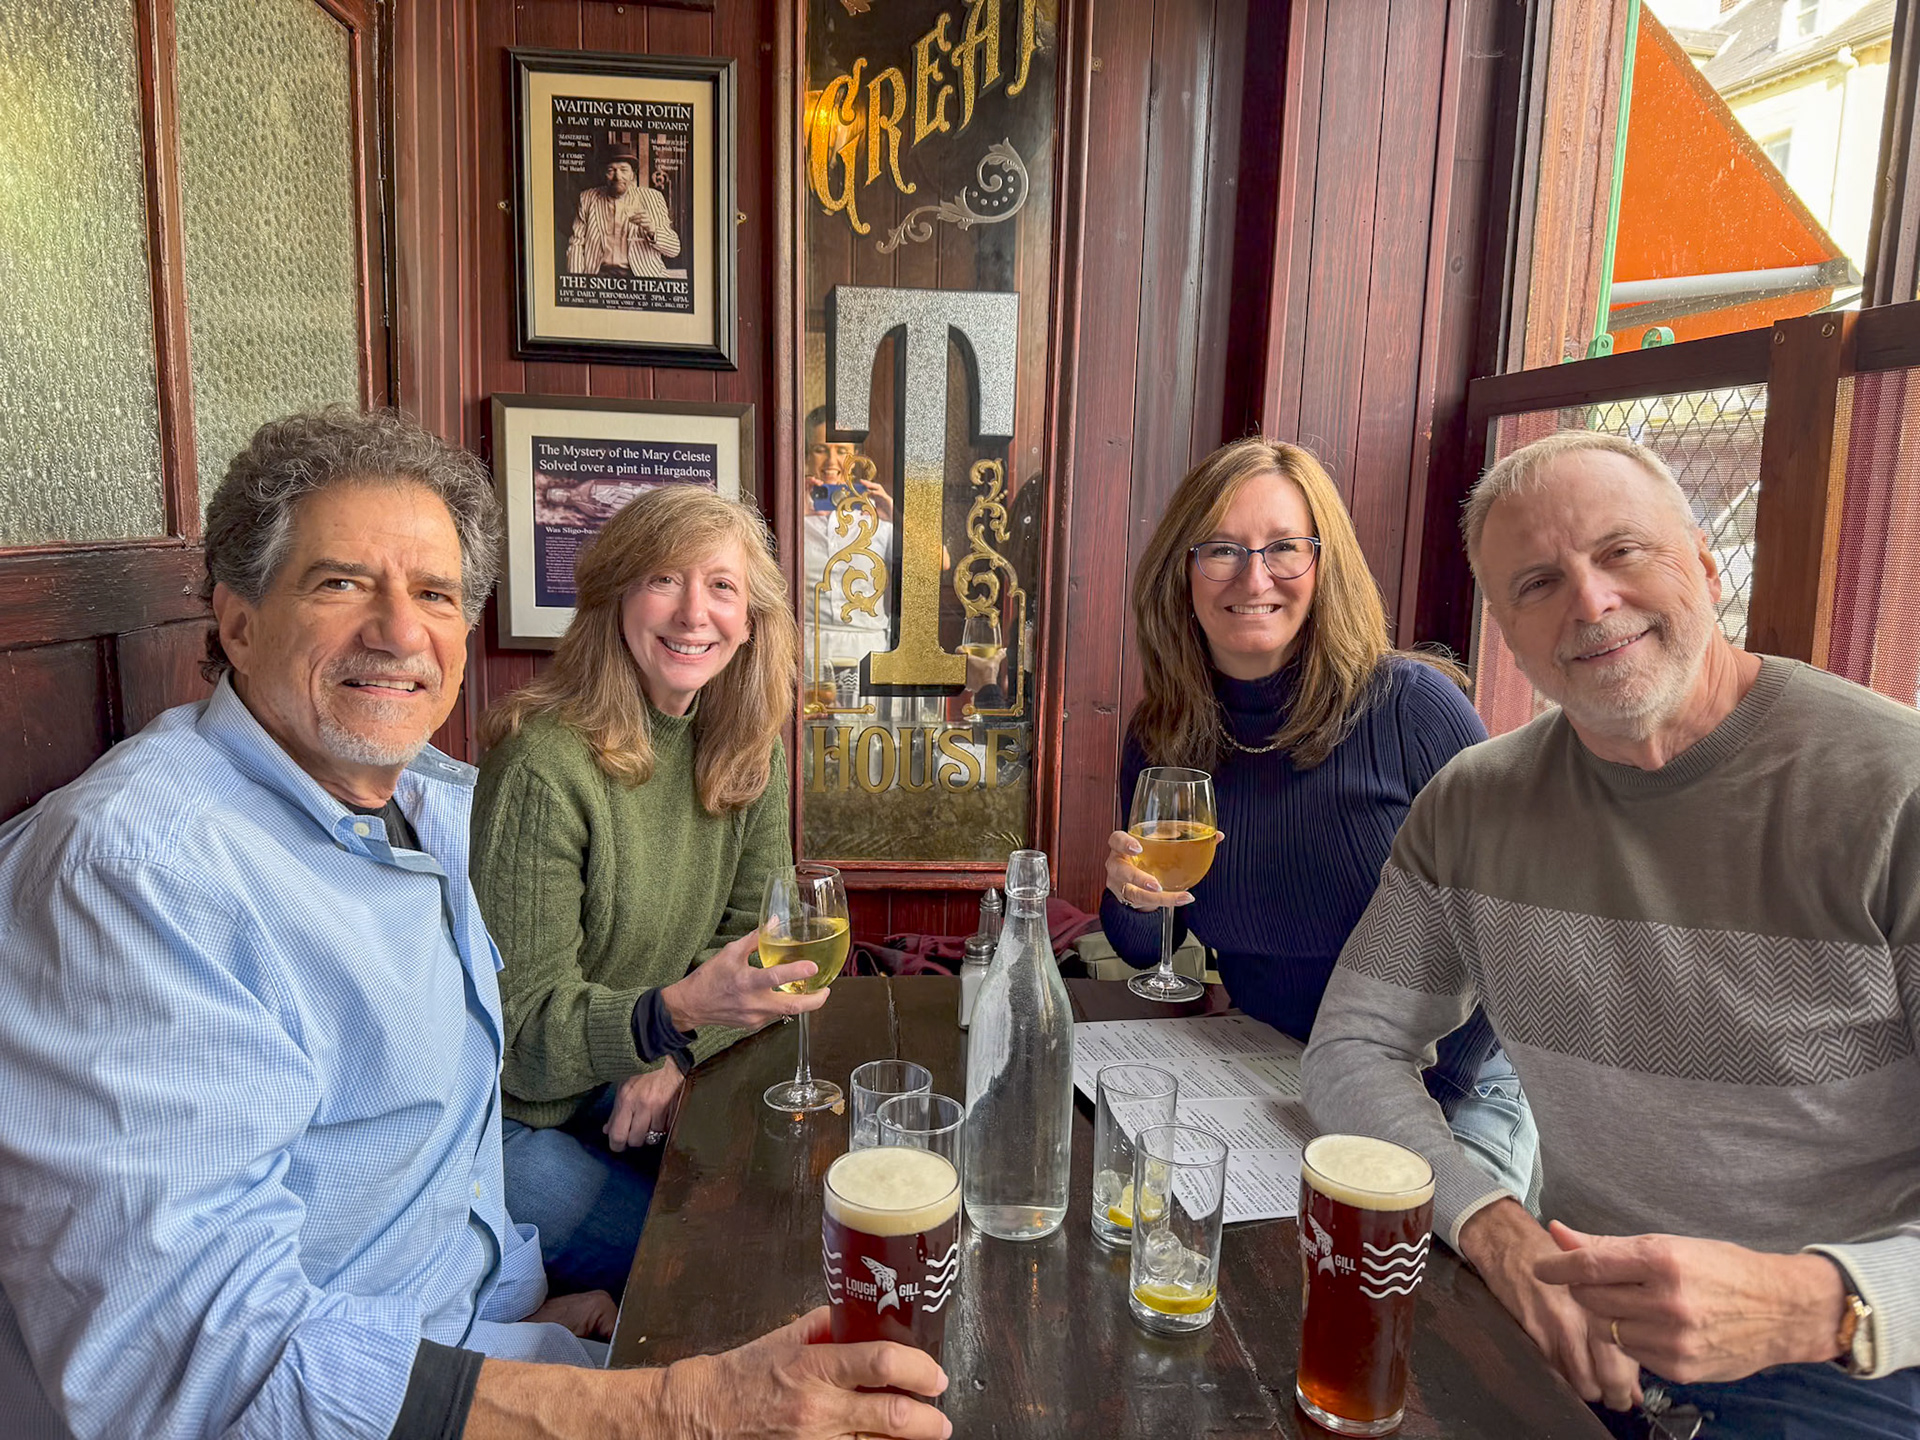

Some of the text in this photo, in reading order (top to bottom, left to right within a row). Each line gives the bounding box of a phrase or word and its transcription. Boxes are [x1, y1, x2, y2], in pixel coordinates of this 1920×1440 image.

[554, 99, 691, 120] WAITING FOR POITÍN
[556, 116, 690, 132] A PLAY BY KIERAN DEVANEY
[558, 140, 592, 148] Sunday Times
[559, 276, 689, 295] THE SNUG THEATRE
[577, 290, 596, 298] DAILY
[600, 292, 647, 300] PERFORMANCE
[538, 443, 711, 463] The Mystery of the Mary Celeste
[539, 460, 577, 472] Solved
[580, 464, 604, 473] over
[616, 464, 638, 477] pint
[641, 465, 651, 475] in
[654, 465, 711, 479] Hargadons
[830, 284, 1019, 690] T
[810, 725, 1022, 795] HOUSE
[1334, 1254, 1357, 1272] GILL
[845, 1276, 921, 1297] LOUGH GILL
